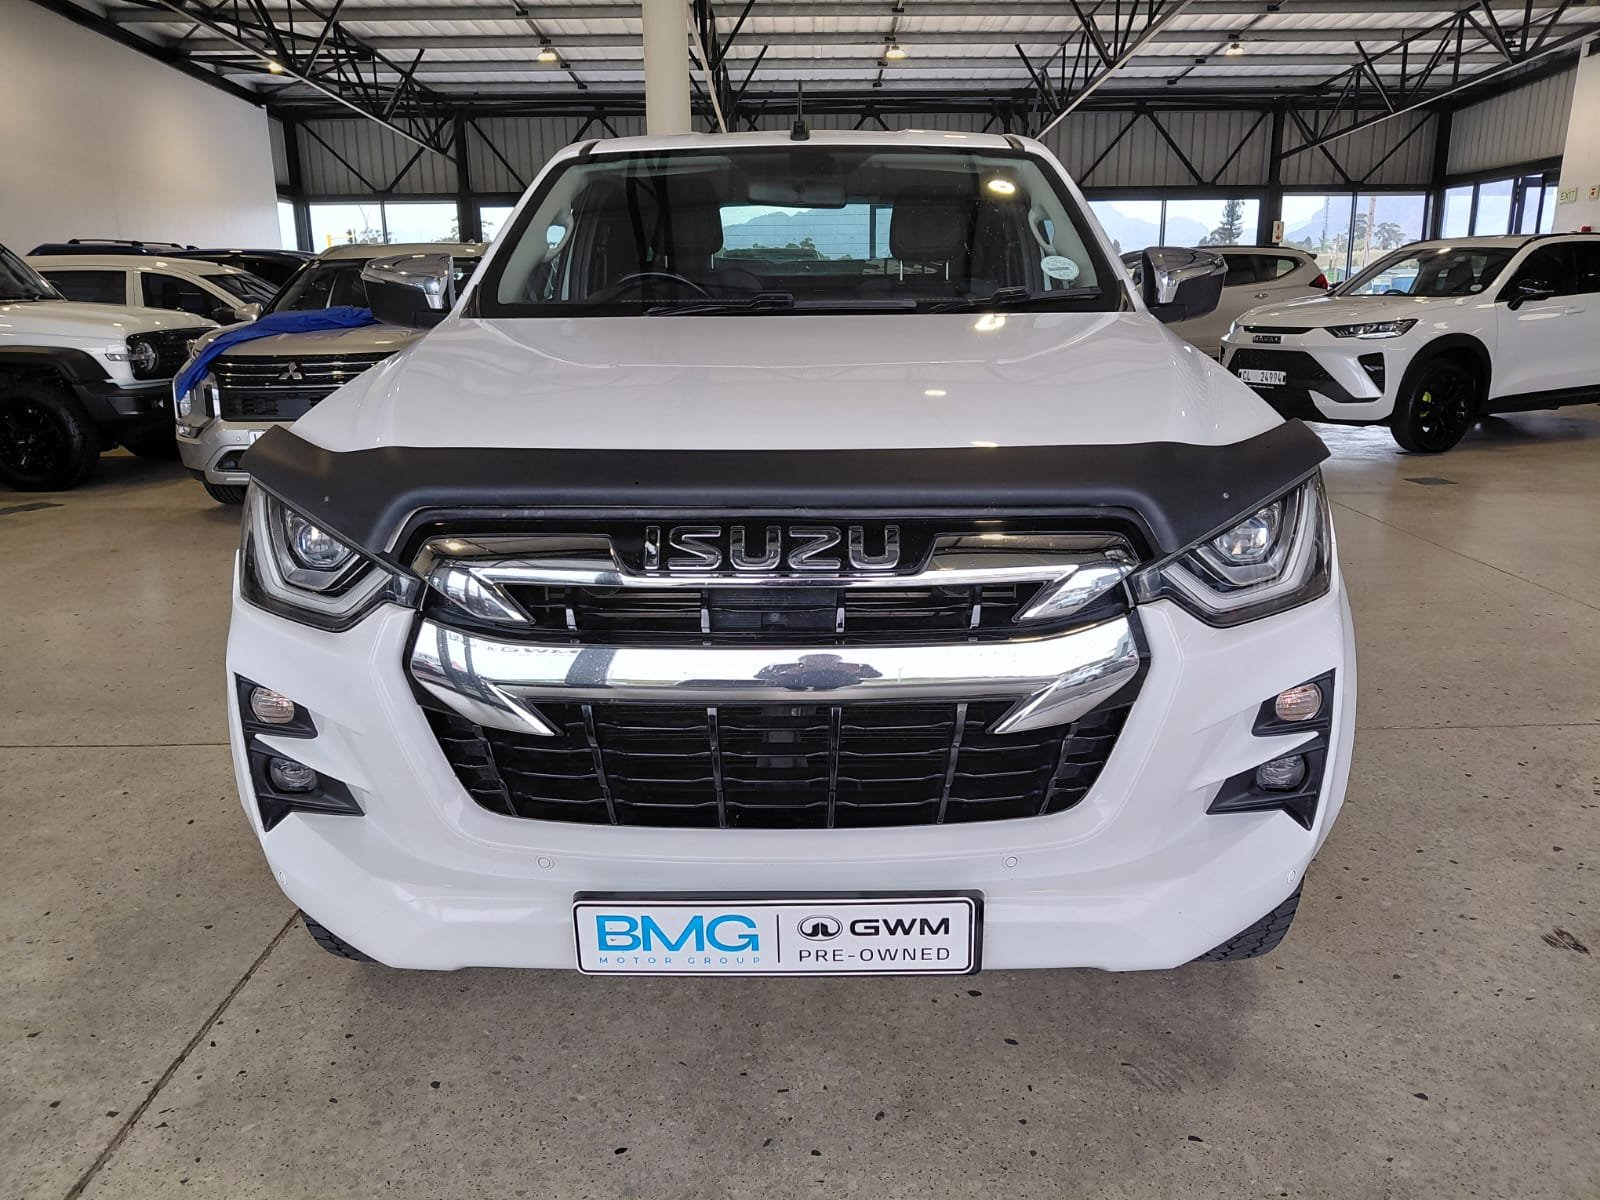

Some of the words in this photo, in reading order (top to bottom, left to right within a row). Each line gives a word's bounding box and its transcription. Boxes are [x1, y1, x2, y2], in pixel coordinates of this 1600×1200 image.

[1560, 191, 1576, 201] EXIT
[1260, 371, 1282, 383] 24994
[644, 525, 900, 570] ISUZU
[595, 914, 760, 953] BMG
[849, 917, 950, 937] GWM
[599, 956, 673, 965] MOTOR
[687, 956, 761, 965] GROUP
[798, 947, 951, 962] PRE-OWNED
